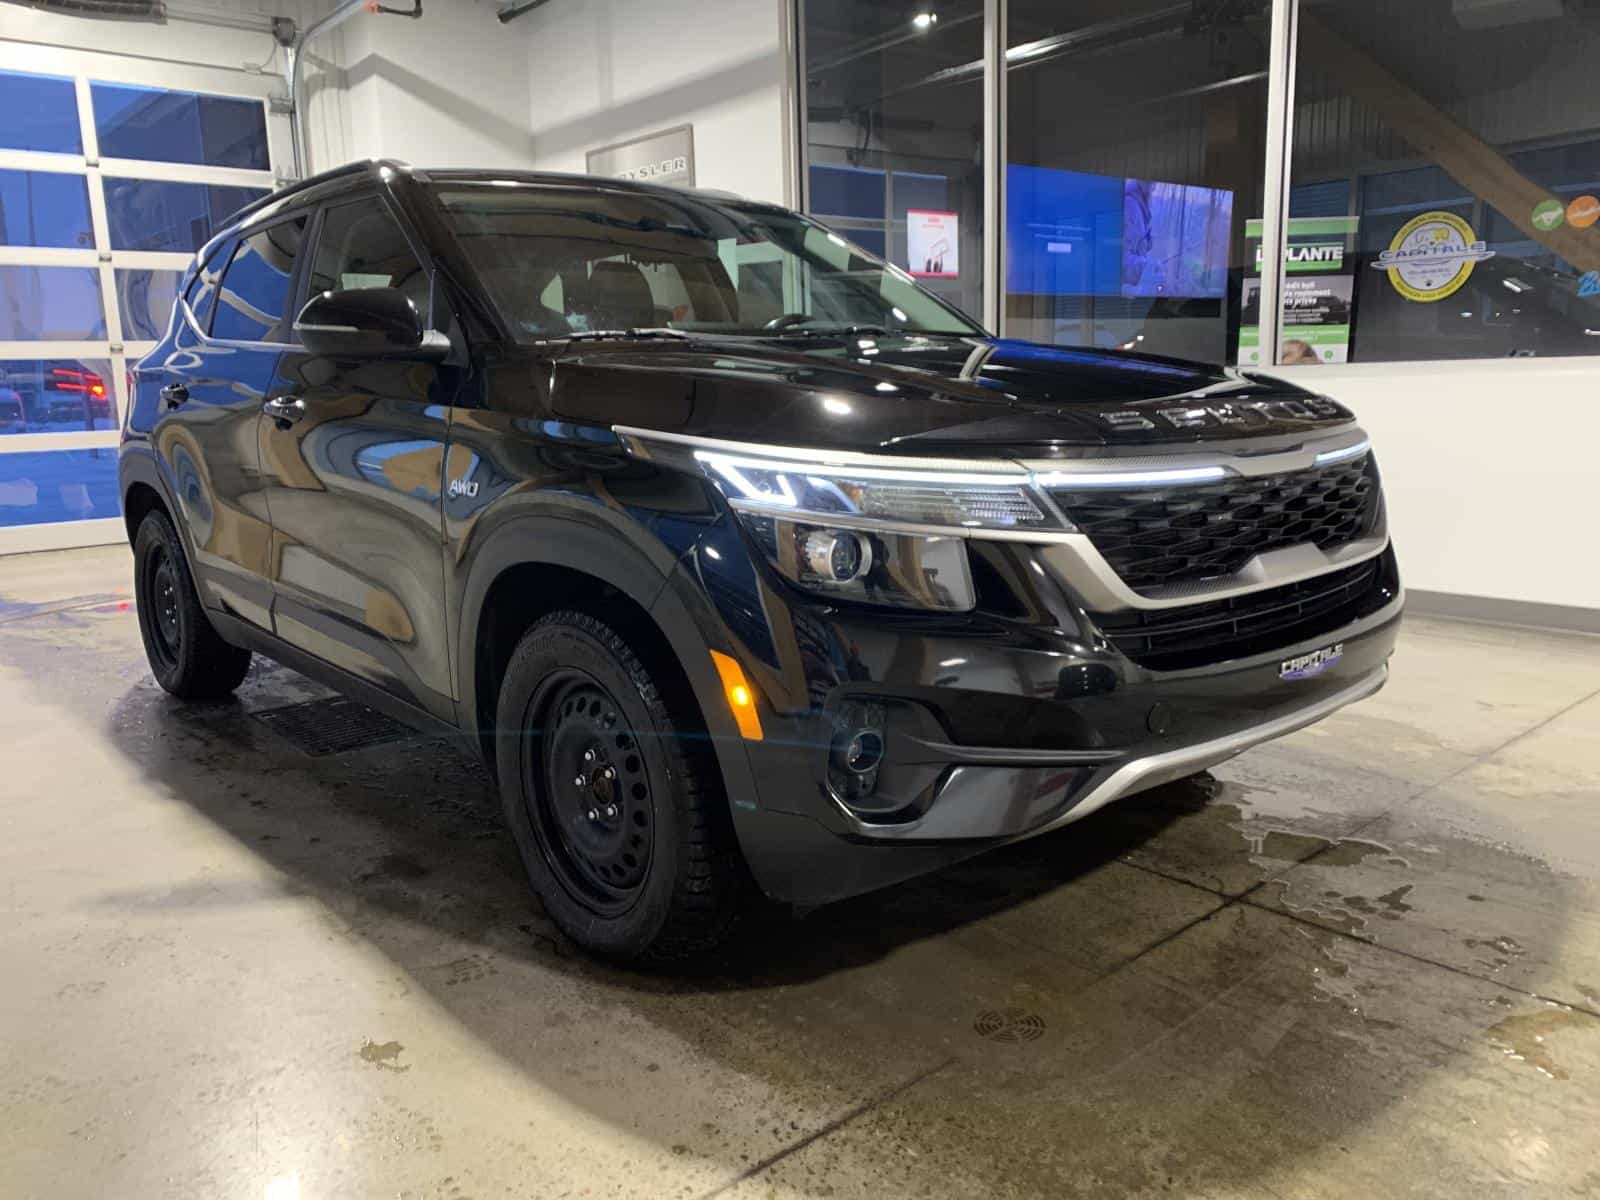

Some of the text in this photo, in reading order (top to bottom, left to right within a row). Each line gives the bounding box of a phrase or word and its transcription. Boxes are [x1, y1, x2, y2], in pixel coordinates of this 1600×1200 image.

[1256, 247, 1343, 262] LLANTE
[449, 479, 479, 497] AWD
[1281, 644, 1343, 673] CAPITALE
